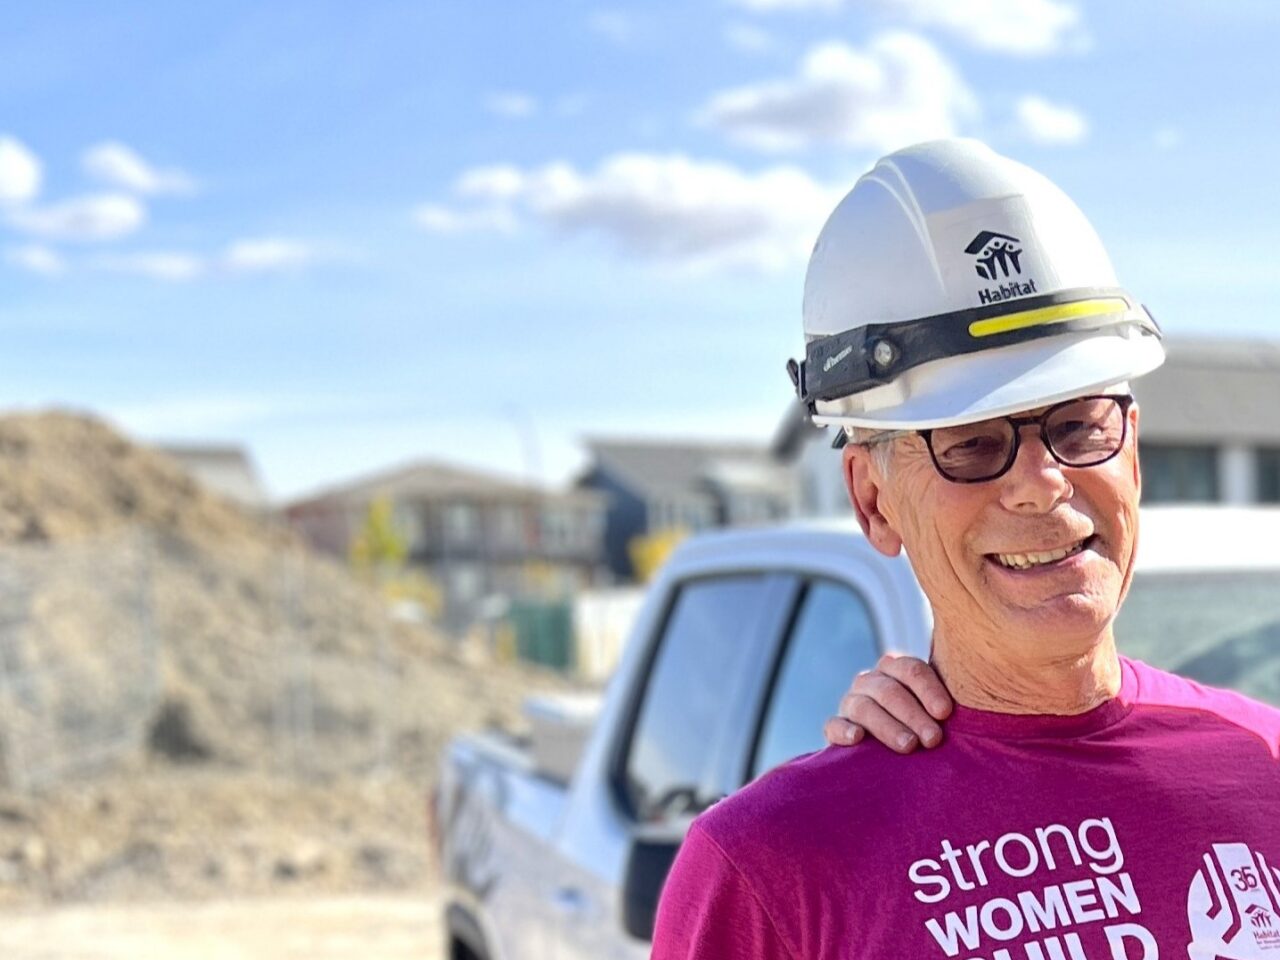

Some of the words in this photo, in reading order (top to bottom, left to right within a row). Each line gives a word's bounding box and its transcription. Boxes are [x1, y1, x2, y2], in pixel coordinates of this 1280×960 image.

[978, 278, 1037, 305] Habitat
[908, 816, 1125, 905] strong
[1230, 866, 1258, 892] 35
[925, 872, 1142, 958] WOMEN
